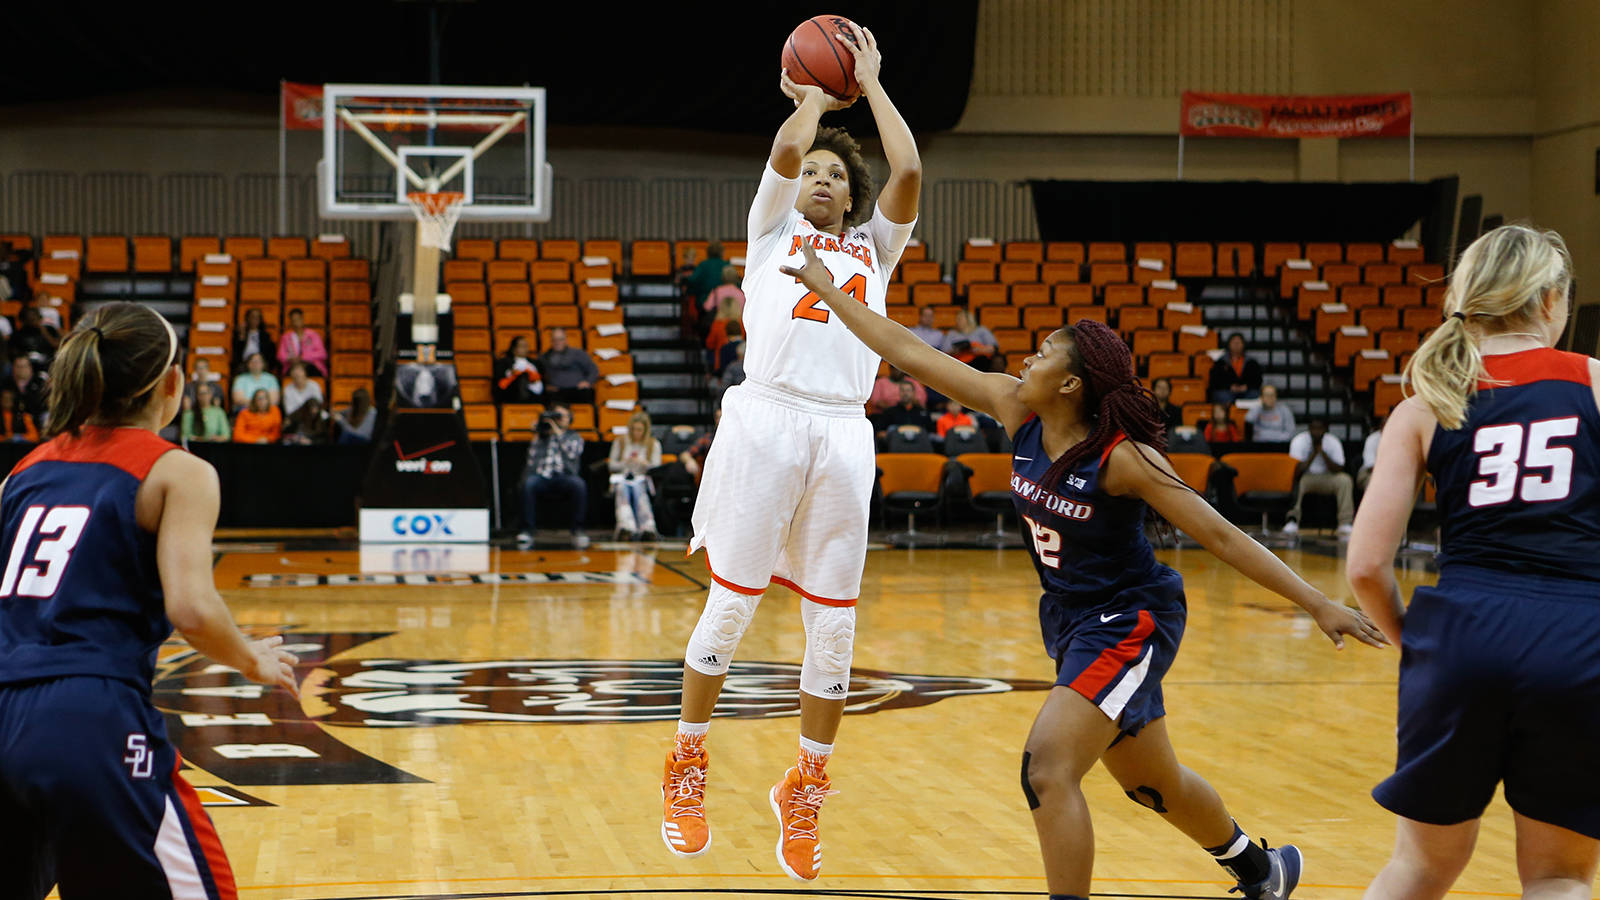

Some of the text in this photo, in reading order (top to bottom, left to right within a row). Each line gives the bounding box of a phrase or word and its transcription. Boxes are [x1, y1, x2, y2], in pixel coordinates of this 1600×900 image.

[1356, 117, 1384, 133] Day
[396, 458, 452, 474] verizon
[1468, 417, 1579, 507] 35
[392, 514, 454, 535] COX
[1022, 514, 1062, 569] 12
[0, 505, 91, 598] 13
